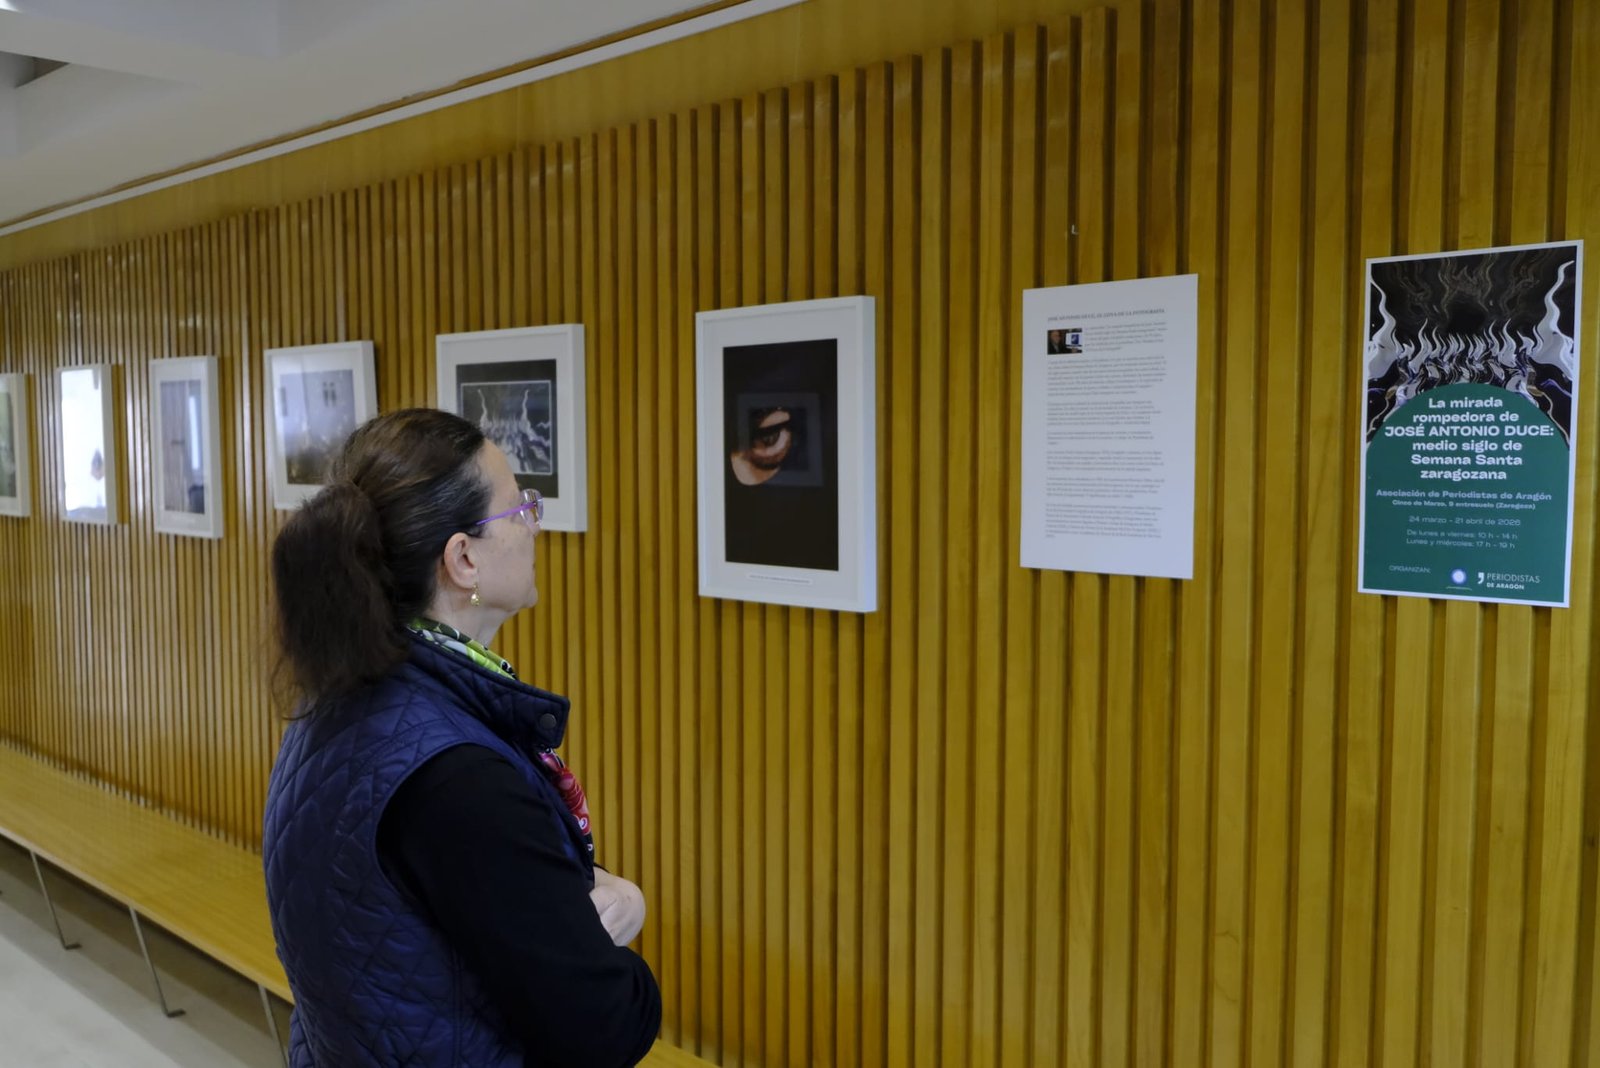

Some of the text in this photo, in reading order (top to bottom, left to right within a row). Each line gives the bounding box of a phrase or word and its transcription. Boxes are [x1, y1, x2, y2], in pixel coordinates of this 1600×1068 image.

[1428, 397, 1503, 408] La mirada
[1413, 411, 1519, 424] rompedora de
[1385, 424, 1554, 437] JOSÉ ANTONIO DUCE:
[1413, 440, 1522, 453] medio siglo de
[1411, 454, 1522, 465] Semana Santa
[1420, 469, 1507, 481] zaragozana
[1376, 489, 1425, 497] Asociación
[1443, 491, 1497, 499] Periodistas
[1516, 492, 1552, 501] Aragón
[1487, 573, 1540, 583] PERIODISTAS
